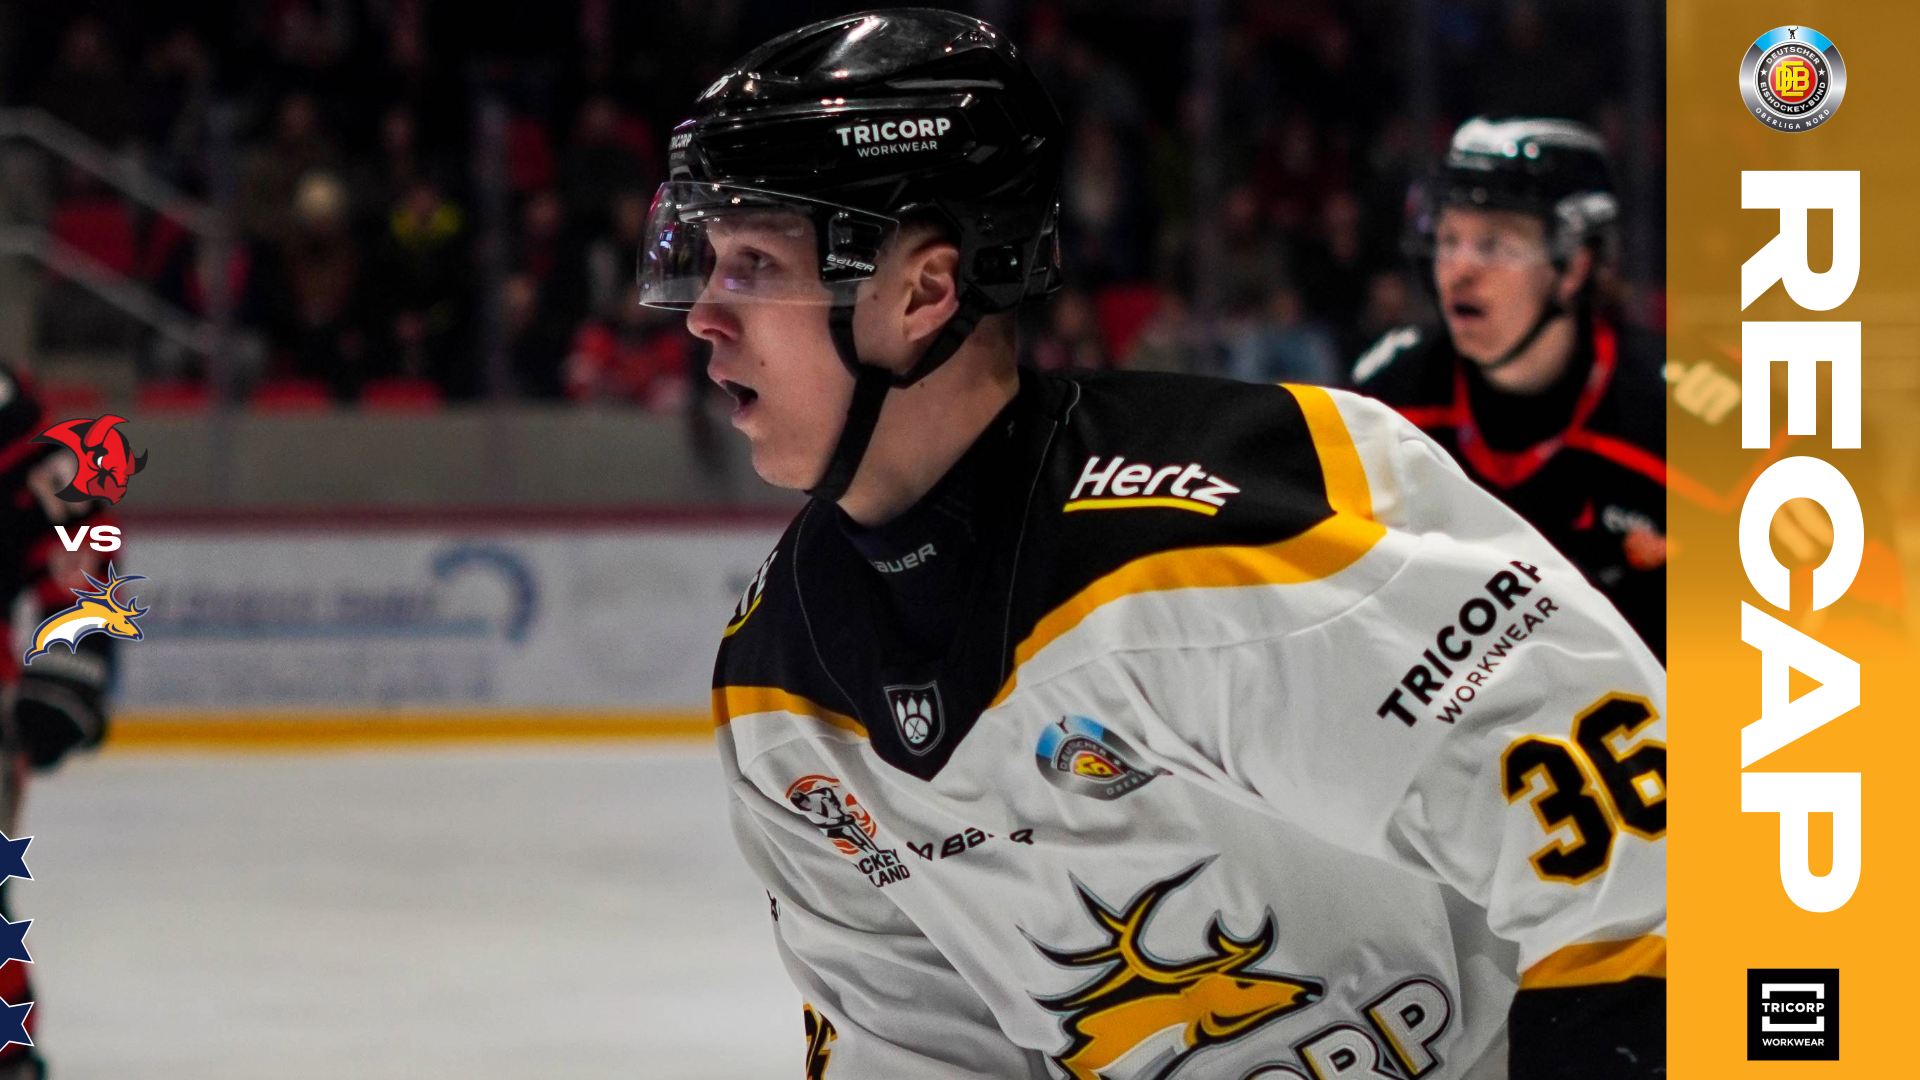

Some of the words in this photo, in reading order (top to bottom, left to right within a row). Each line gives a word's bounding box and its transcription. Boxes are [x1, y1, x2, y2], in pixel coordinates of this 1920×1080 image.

[836, 116, 952, 147] TRICORP
[857, 140, 938, 158] WORKWEAR
[1069, 456, 1241, 507] Hertz
[1377, 561, 1542, 728] TRICORP
[1436, 596, 1559, 725] WORKWEAR
[1500, 690, 1667, 887] 36
[853, 848, 902, 876] CKEY
[868, 864, 911, 888] LAND
